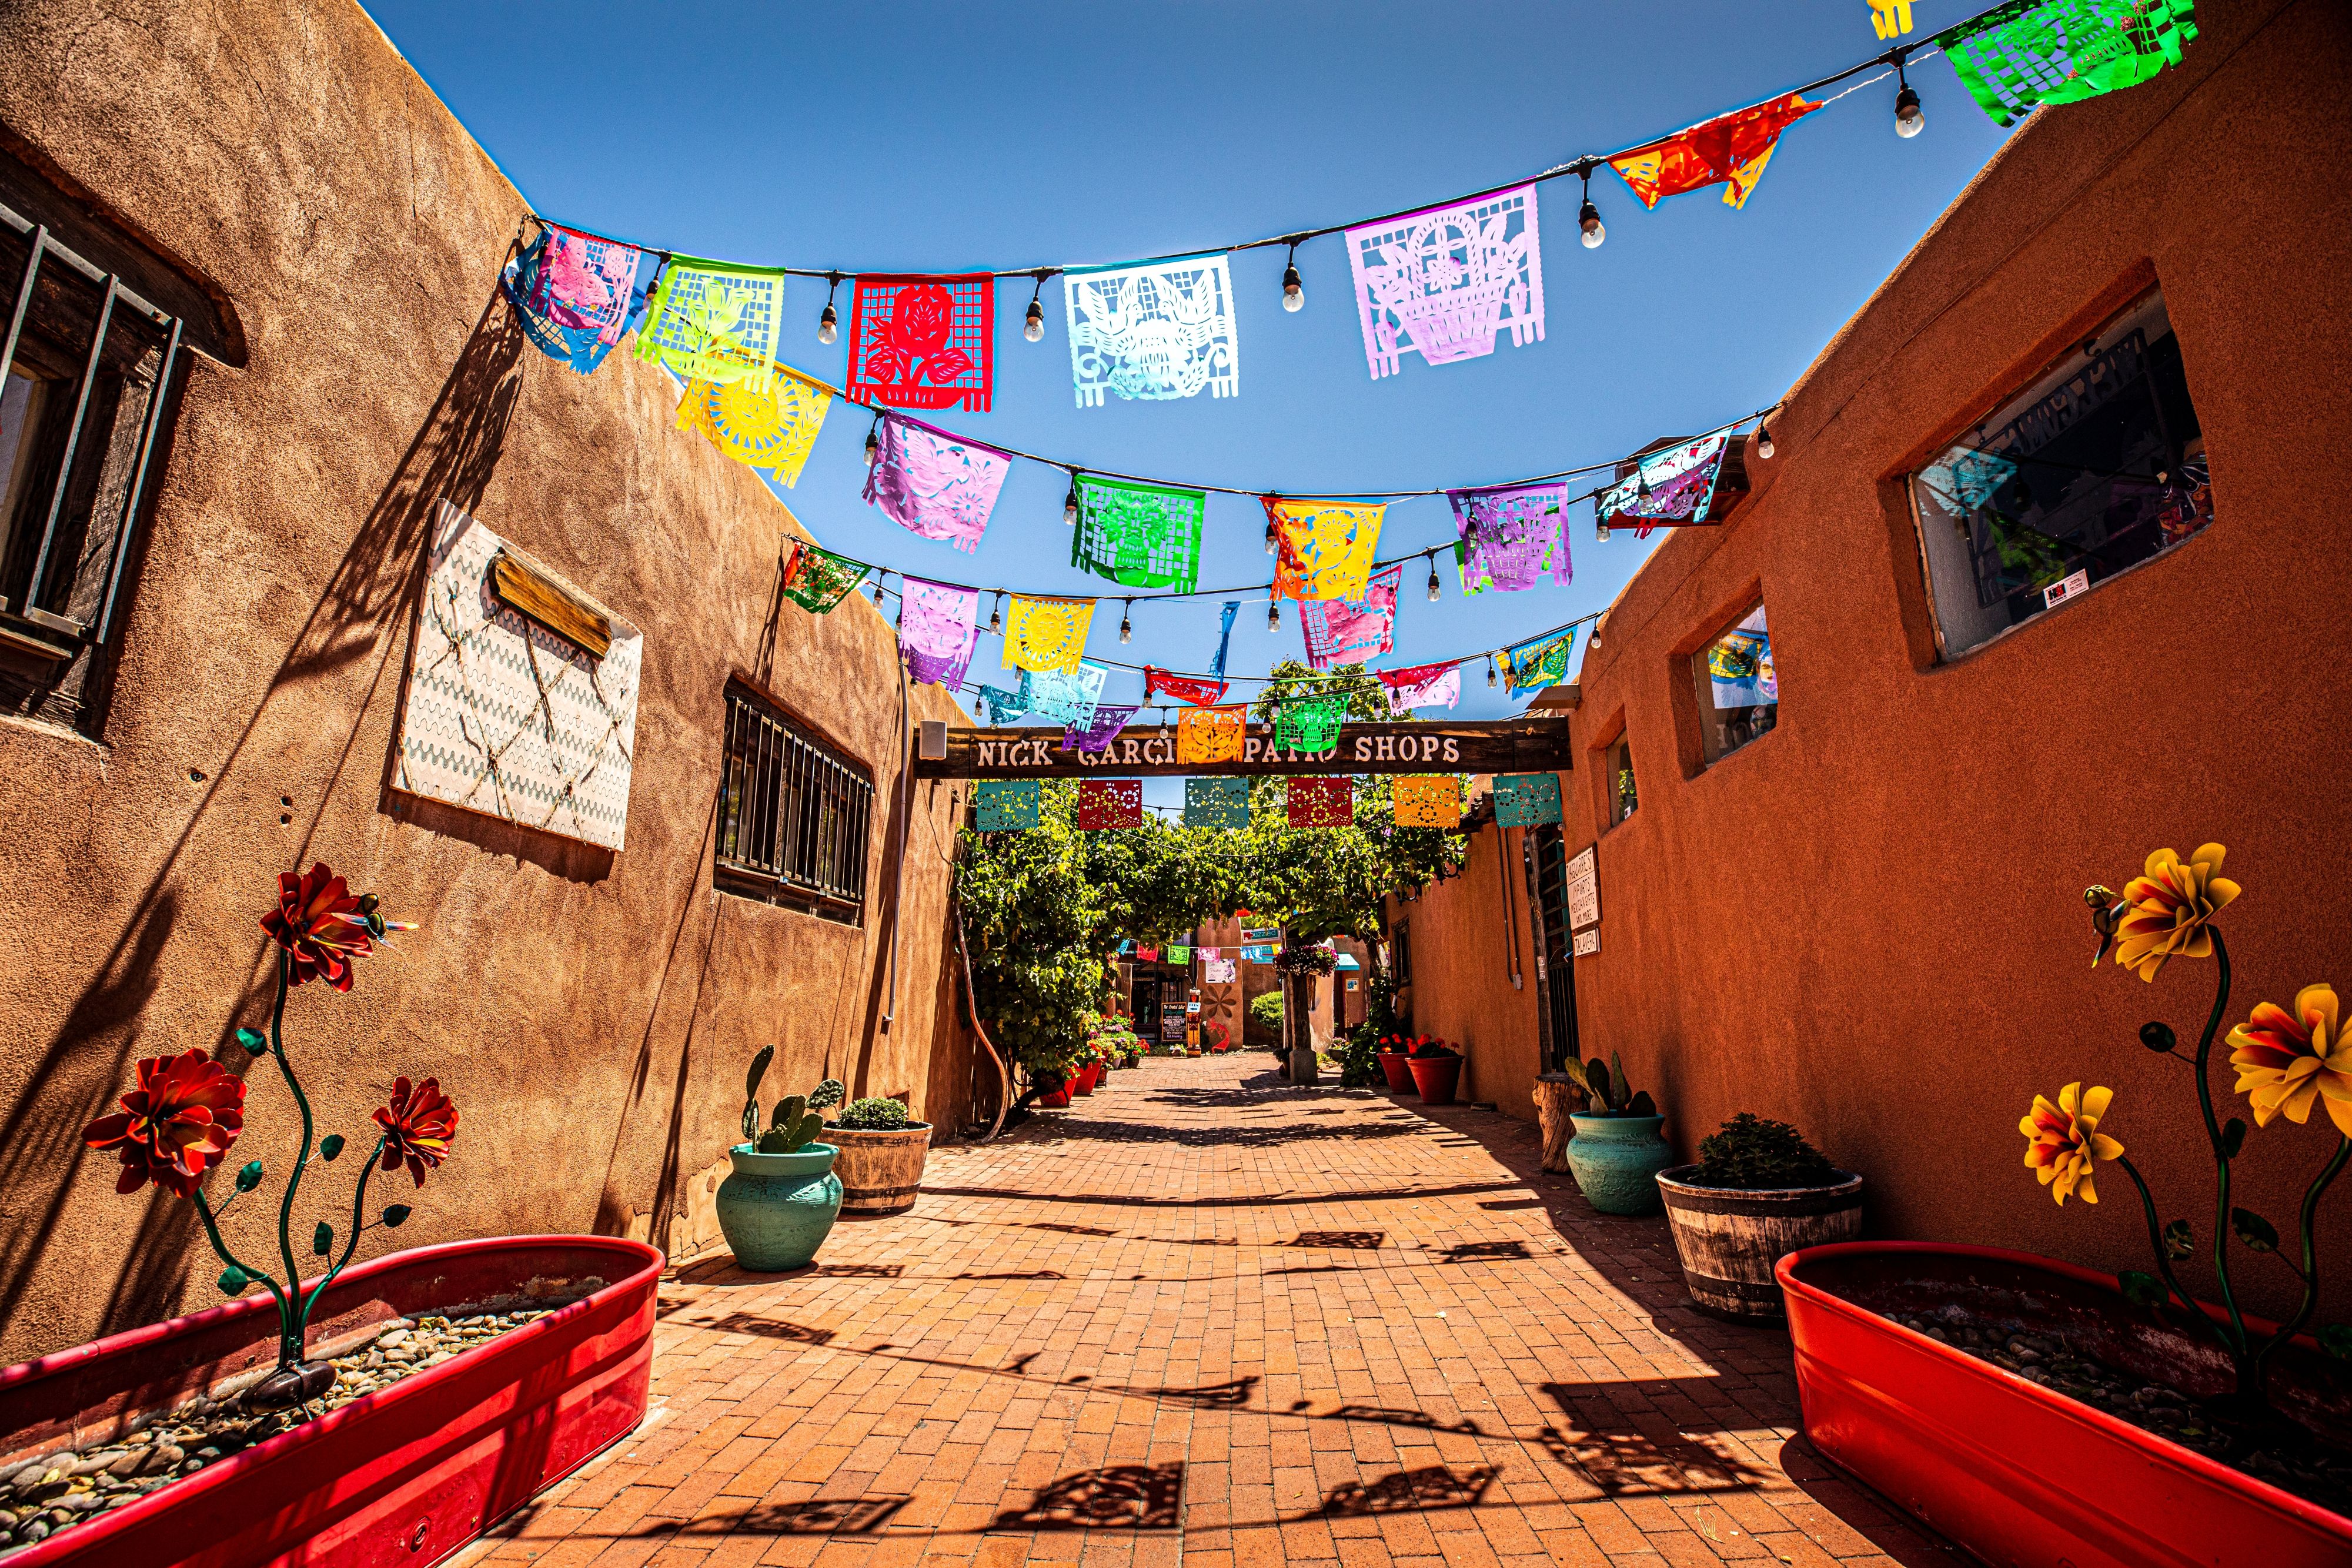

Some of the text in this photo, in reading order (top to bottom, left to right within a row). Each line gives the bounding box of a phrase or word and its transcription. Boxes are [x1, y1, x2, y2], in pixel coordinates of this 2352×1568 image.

[977, 738, 1053, 767] NICK
[1078, 738, 1175, 767] GARCI
[1355, 735, 1460, 763] SHOPS
[1572, 877, 1591, 898] IMPORTS
[1571, 891, 1595, 914] MEXICAN GIFTS
[1582, 909, 1592, 922] MORE
[1250, 930, 1276, 939] puzzed
[1575, 932, 1595, 954] TALAVERA
